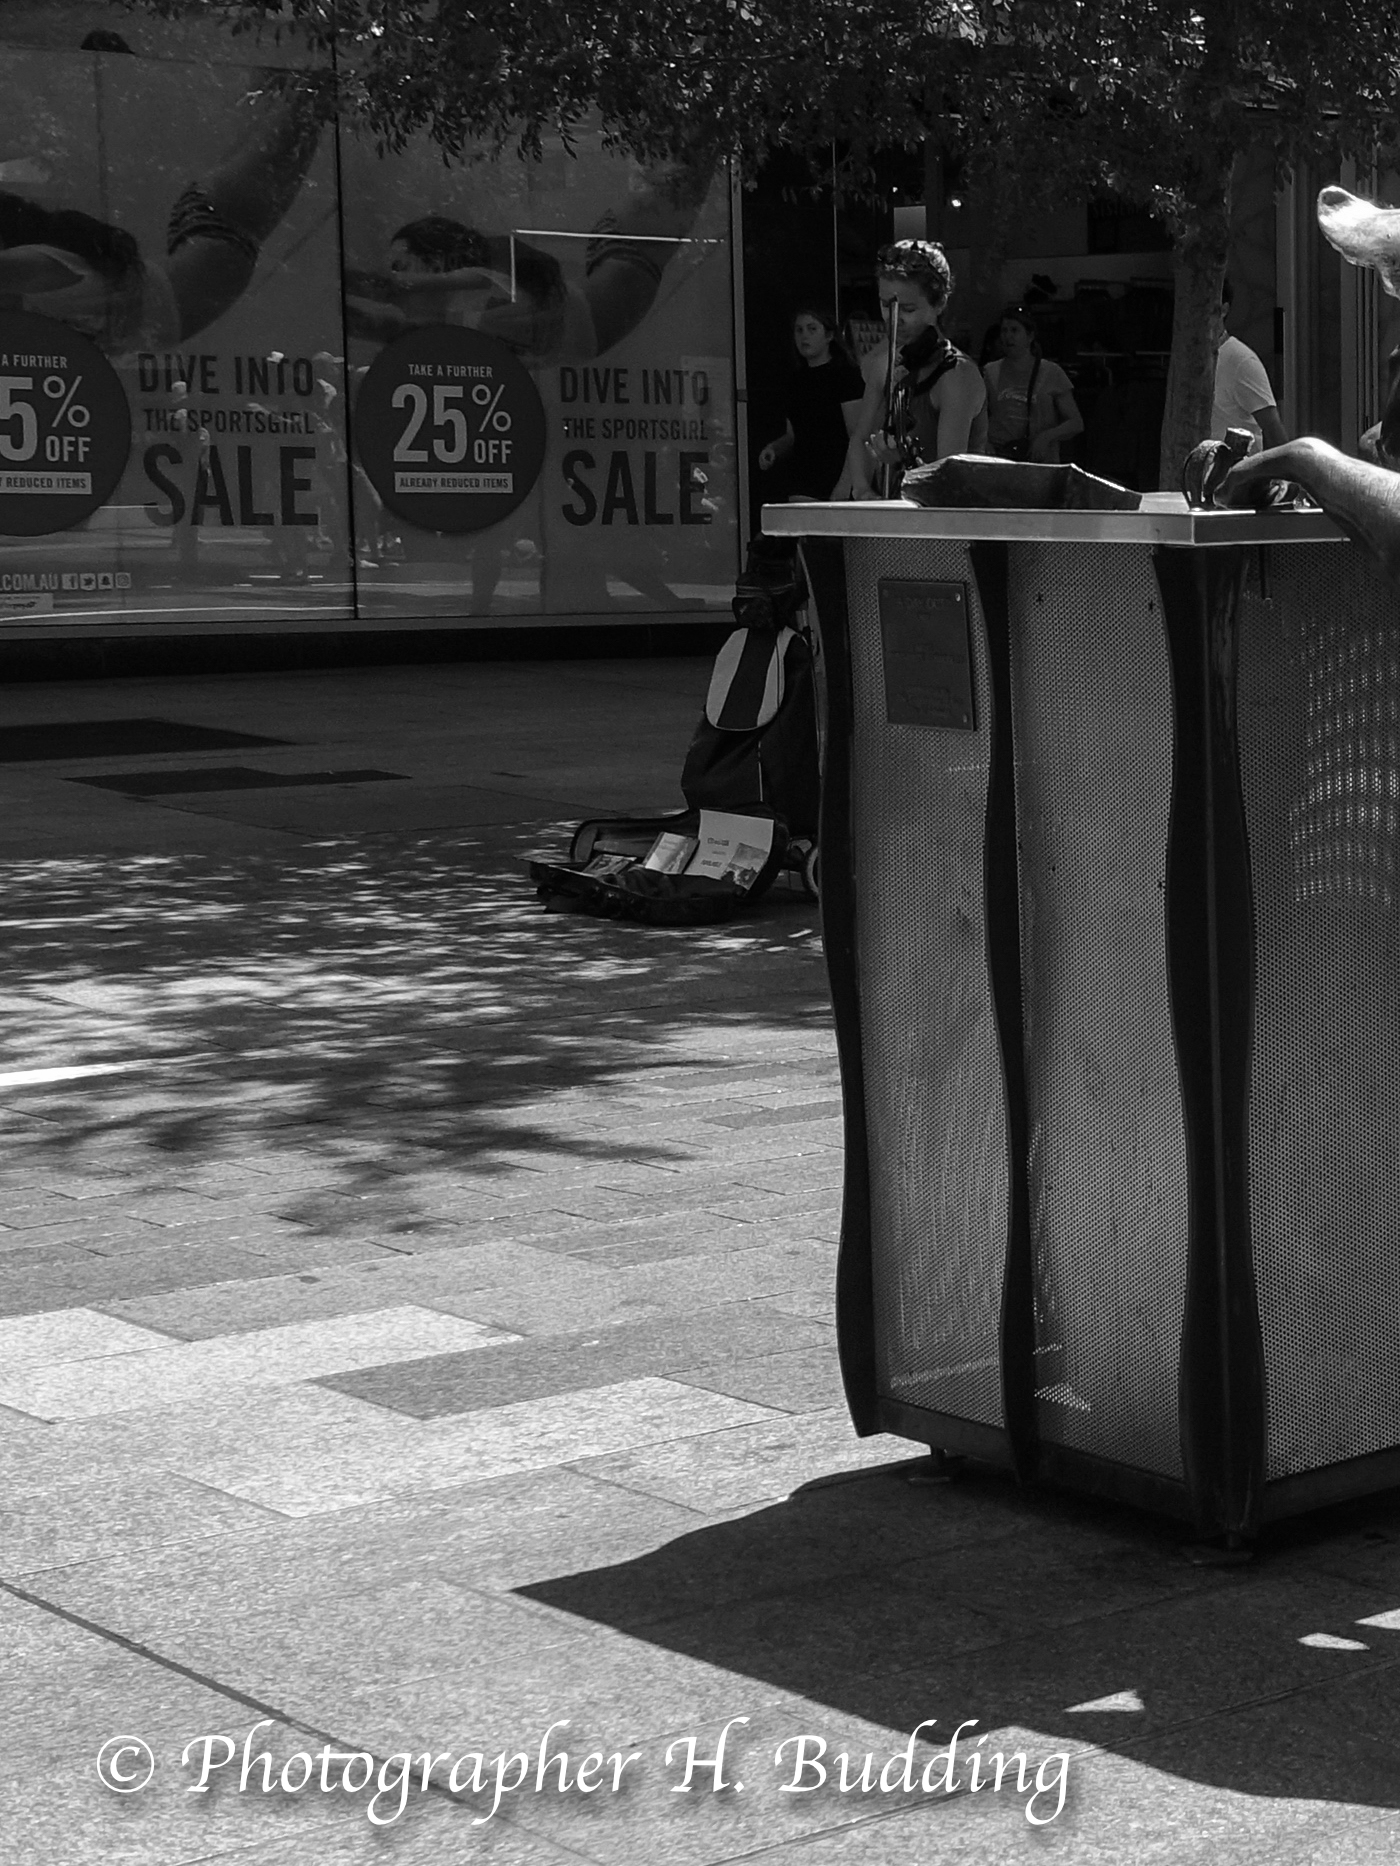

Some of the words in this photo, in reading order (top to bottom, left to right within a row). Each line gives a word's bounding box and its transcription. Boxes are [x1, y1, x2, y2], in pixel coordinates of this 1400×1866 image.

[1, 353, 10, 367] A
[13, 354, 69, 369] FURTHER
[138, 352, 220, 396] DIVE
[235, 355, 315, 397] INTO
[408, 364, 434, 378] TAKE
[437, 365, 445, 378] A
[447, 365, 494, 379] FURTHER
[559, 366, 630, 405] DIVE
[641, 368, 711, 407] INTO
[143, 407, 182, 434] THE
[189, 409, 315, 436] SPORTSGIRL
[391, 383, 513, 464] 25%
[563, 417, 595, 440] THE
[601, 418, 710, 442] SPORTSGIRL
[45, 435, 91, 463] OFF
[473, 439, 513, 465] OFF
[6, 476, 53, 489] REDUCED
[56, 477, 87, 490] ITEMS
[143, 443, 319, 527] SALE
[400, 476, 438, 489] ALREADY
[440, 476, 480, 489] REDUCED
[482, 476, 509, 489] ITEMS
[562, 449, 713, 527] SALE
